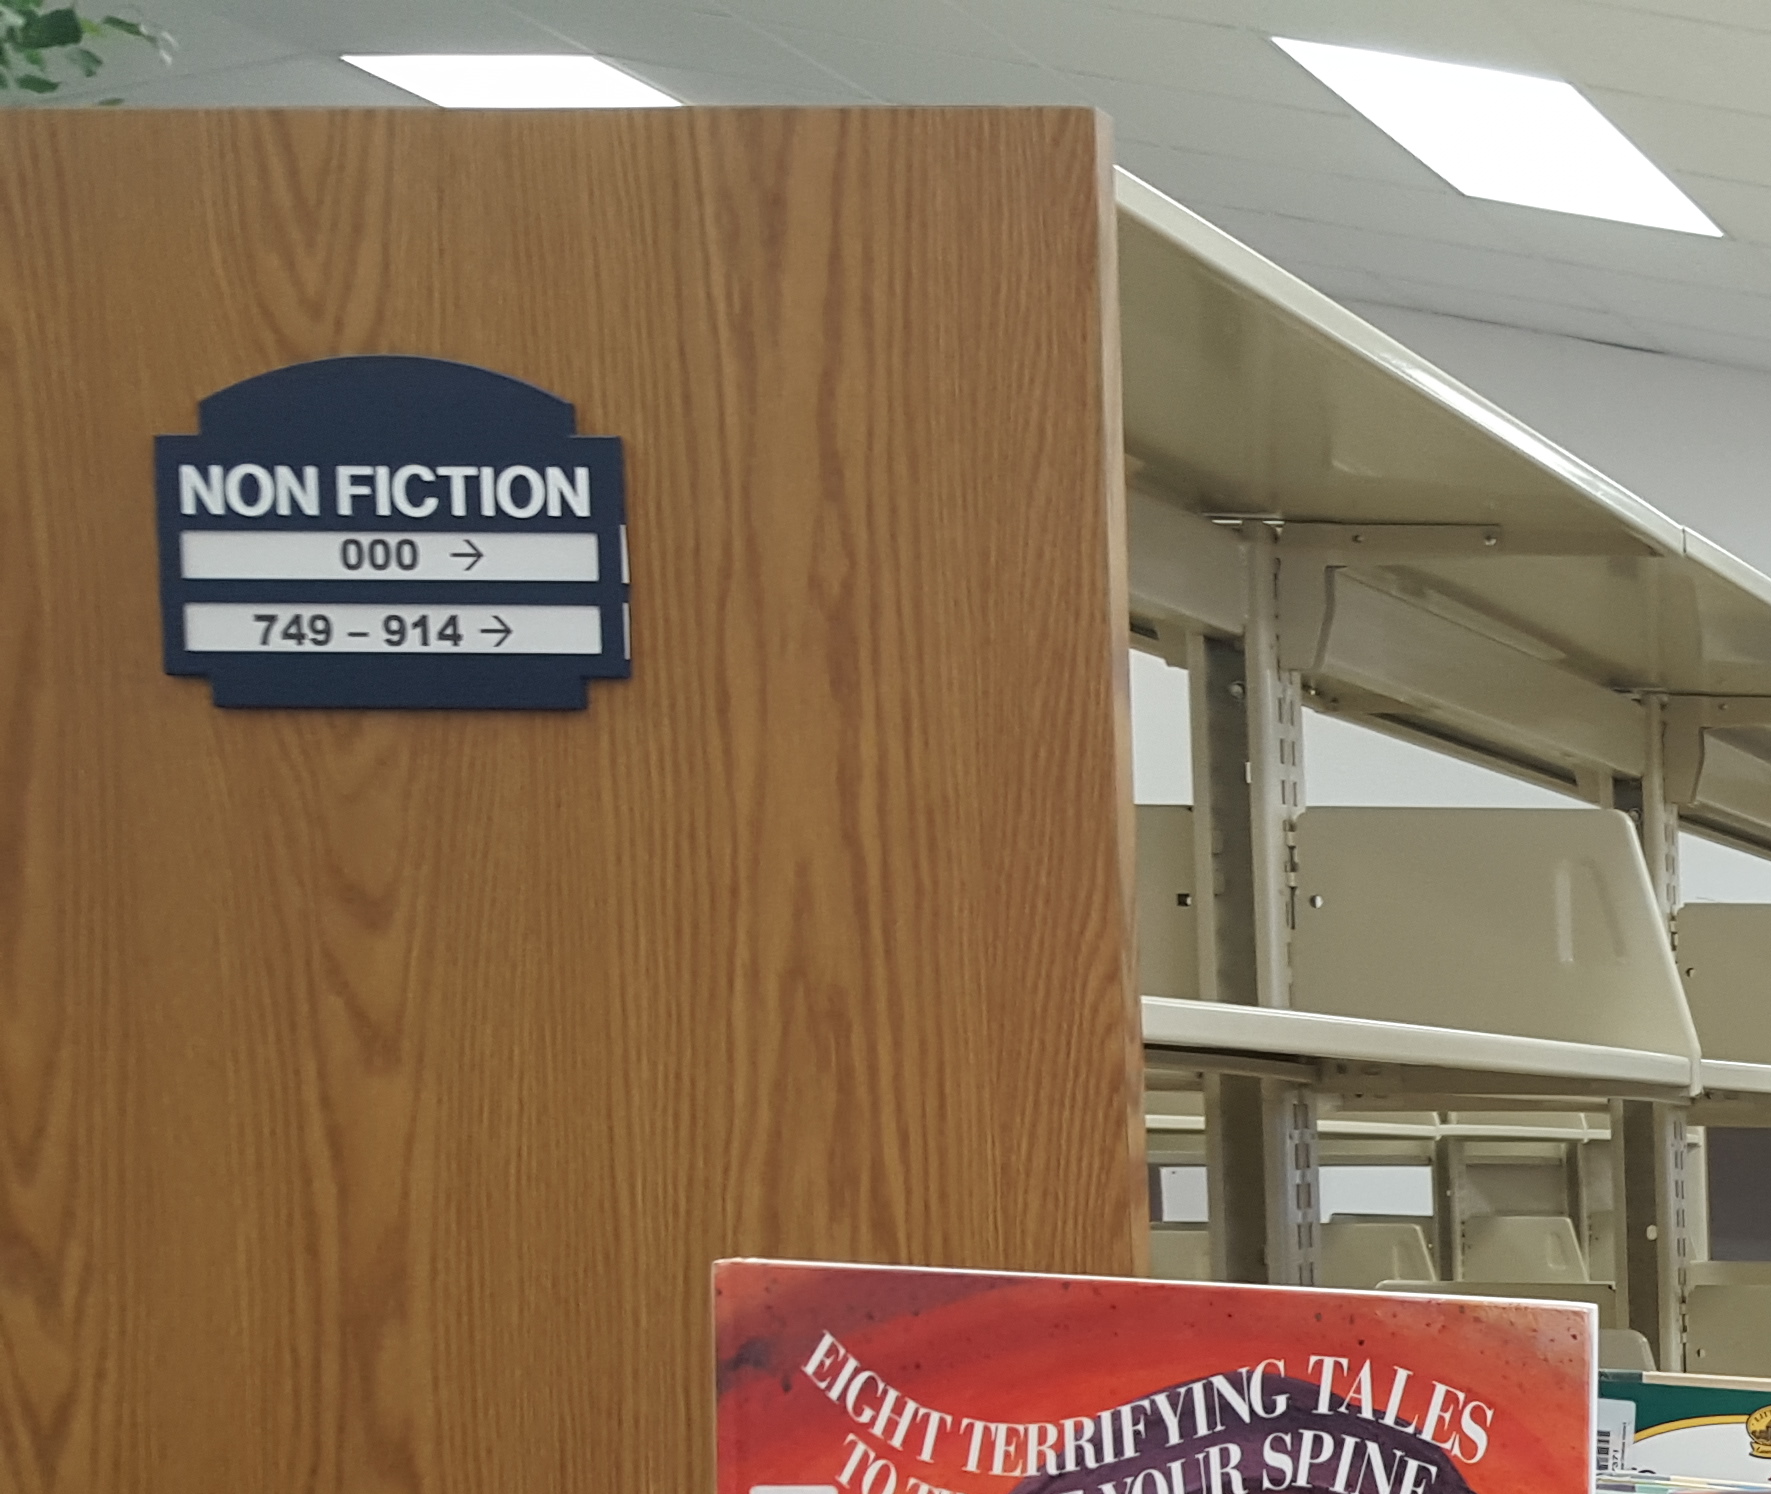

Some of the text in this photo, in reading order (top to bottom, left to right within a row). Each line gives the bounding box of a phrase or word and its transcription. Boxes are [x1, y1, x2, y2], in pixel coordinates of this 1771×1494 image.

[178, 464, 592, 519] NON FICTION
[341, 538, 420, 571] 000
[253, 614, 464, 648] 749 914
[800, 1330, 1498, 1478] EIGHT TERRIFYING TALES
